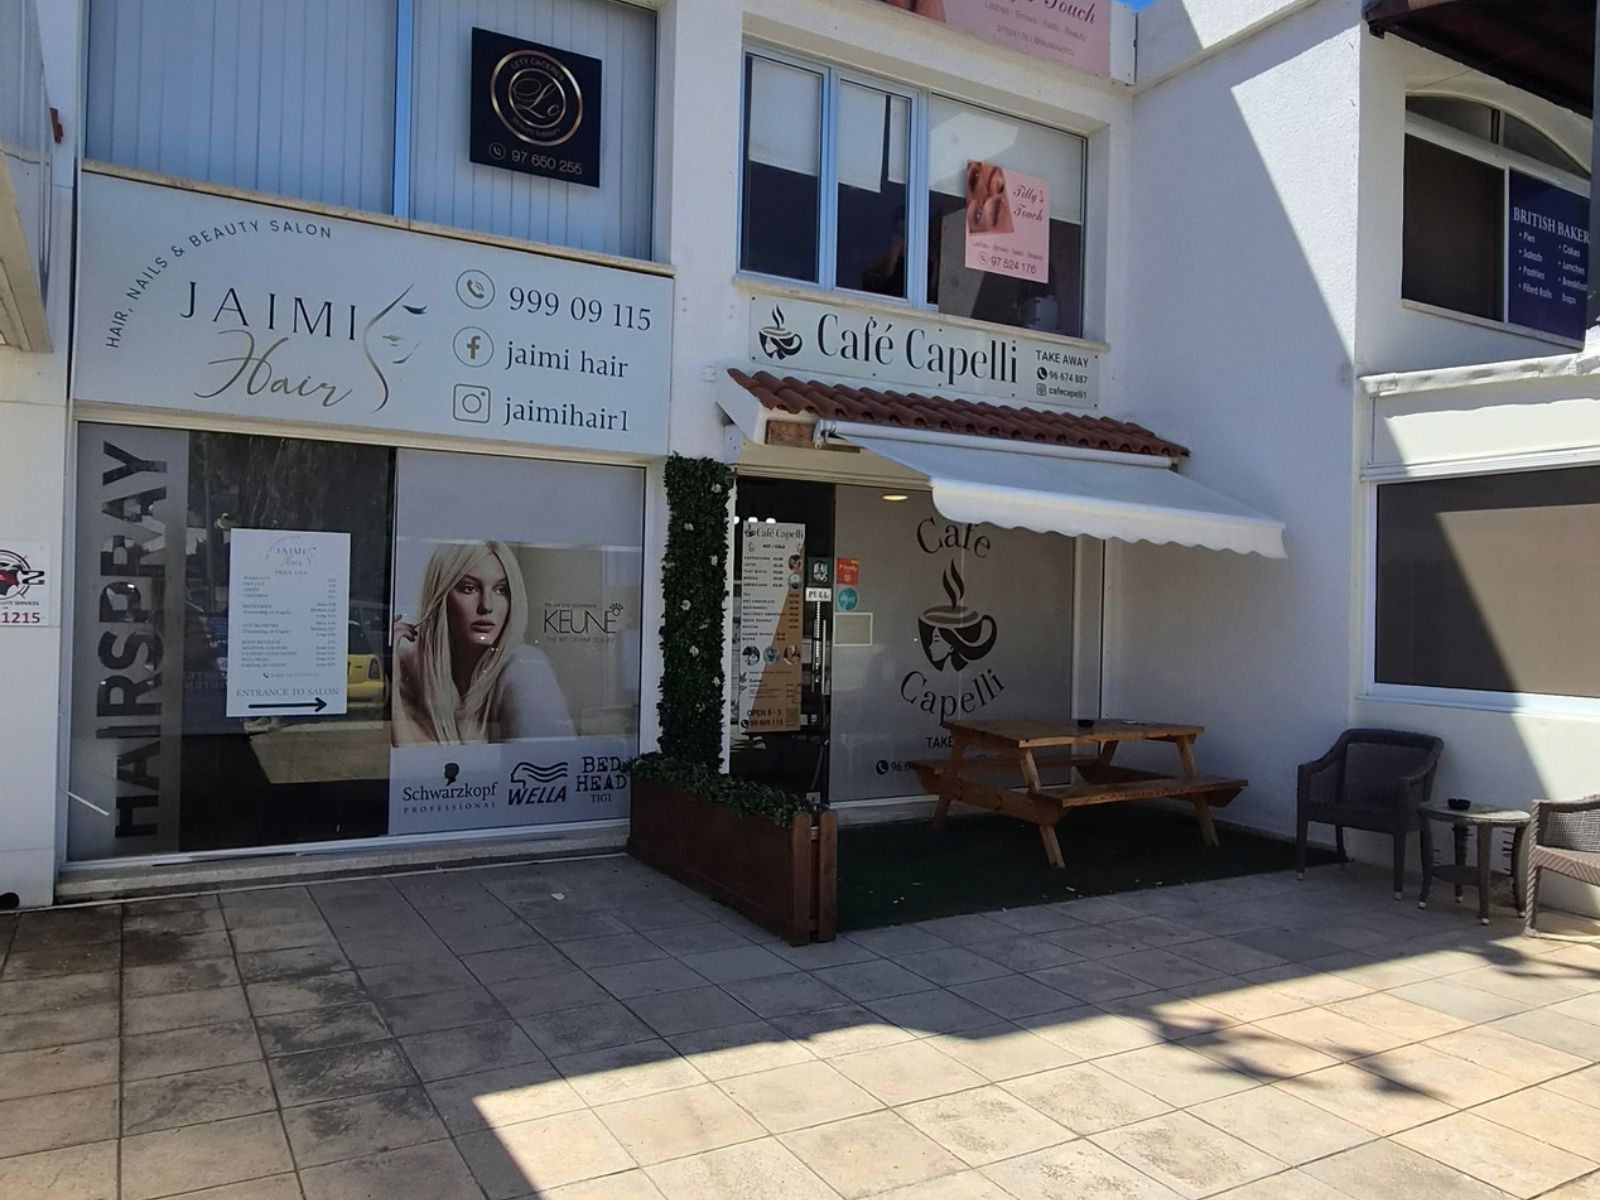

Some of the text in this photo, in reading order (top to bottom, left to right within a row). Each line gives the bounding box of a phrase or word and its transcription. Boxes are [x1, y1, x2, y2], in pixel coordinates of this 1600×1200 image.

[512, 150, 583, 175] 97 650 255
[1013, 204, 1044, 222] Touch
[1513, 206, 1590, 244] BRITISH BAKER
[1003, 259, 1020, 271] 524
[1021, 263, 1037, 274] 176
[106, 220, 332, 349] HAIR, NAILS & BEAUTY SALON
[509, 286, 652, 332] 999 09 115
[505, 341, 629, 379] jaimi hair
[817, 313, 1018, 386] Café Capelli
[1035, 349, 1089, 368] TAKE AWAY
[194, 328, 353, 408] Hair
[504, 397, 629, 432] jaimihair1
[756, 527, 804, 540] Café Capelli
[808, 590, 830, 599] PULL
[1, 611, 41, 624] 1215
[544, 609, 617, 634] KEUNE
[96, 440, 168, 838] HAIRSPRAY
[236, 686, 340, 698] ENTRANCE TO SALON
[900, 667, 1005, 727] Capelli
[926, 736, 955, 749] TAKE
[581, 755, 622, 775] BED
[402, 780, 499, 802] Schwarzkopf
[575, 774, 628, 793] HEAD
[507, 785, 568, 807] WELLA
[591, 793, 613, 804] TIGI
[403, 801, 497, 814] PROFESSIONAL
